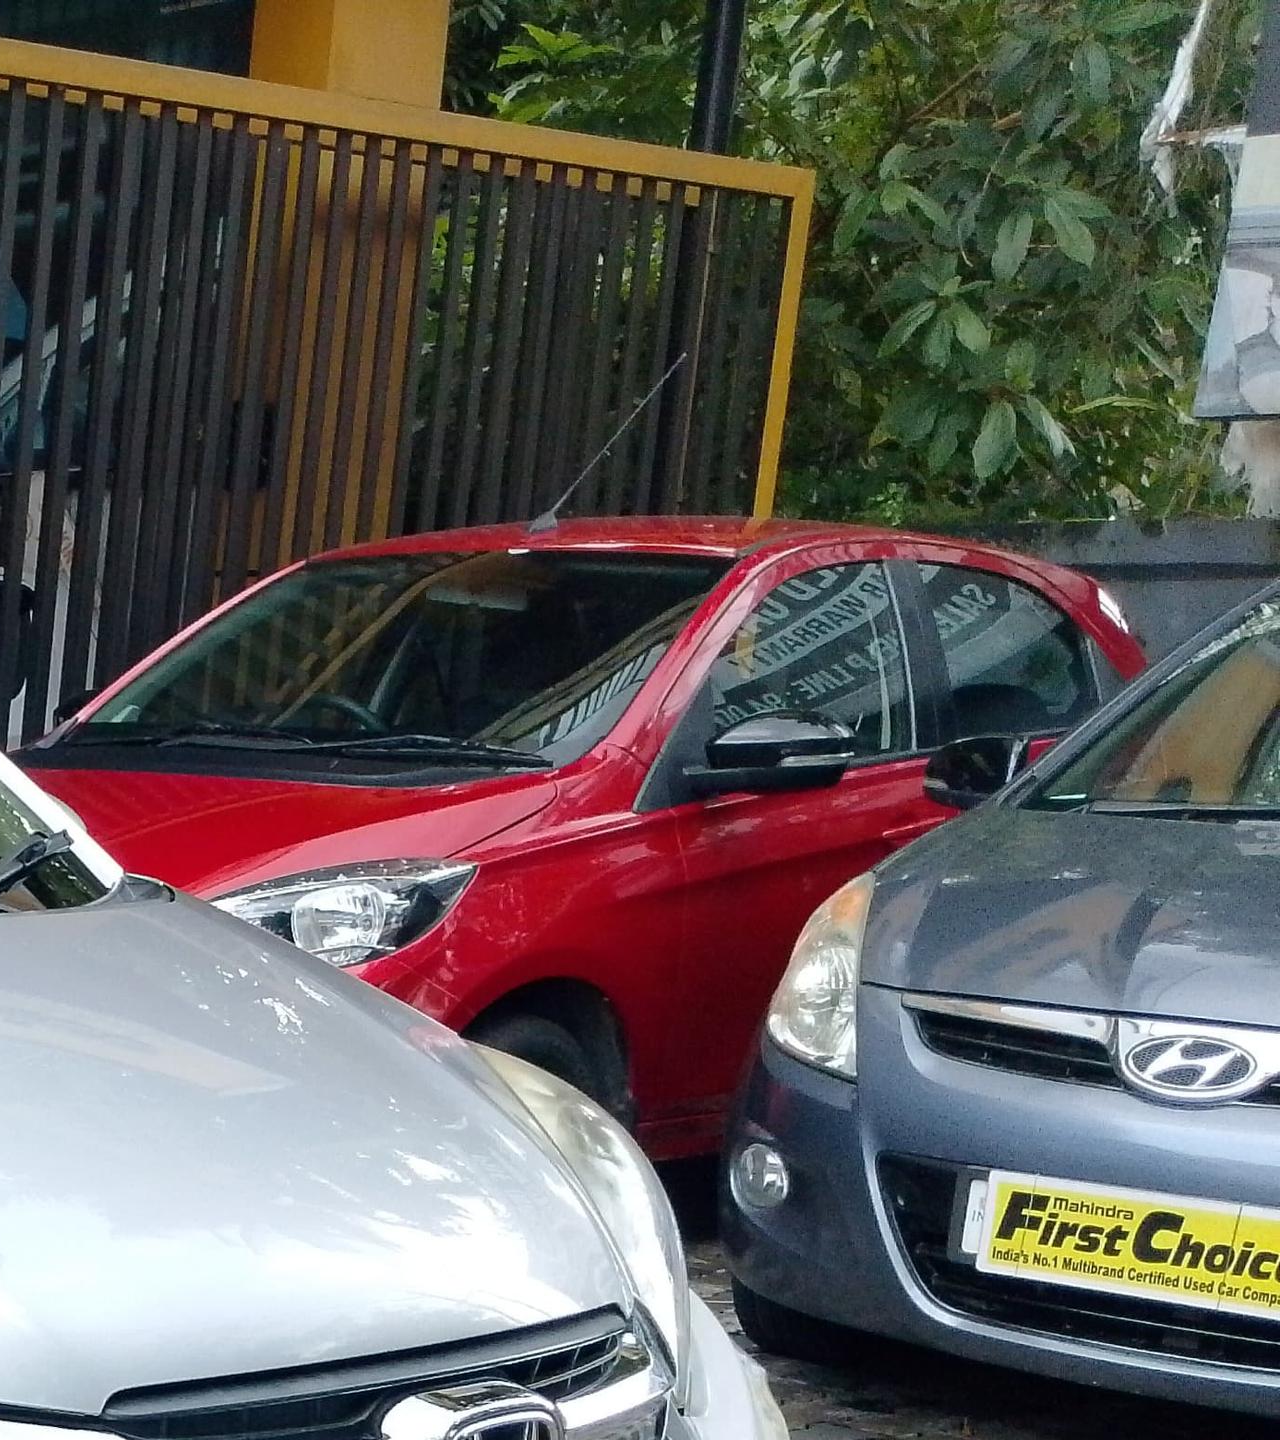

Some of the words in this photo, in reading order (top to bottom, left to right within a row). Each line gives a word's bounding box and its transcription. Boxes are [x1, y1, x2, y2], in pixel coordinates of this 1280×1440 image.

[1053, 1197, 1134, 1220] Mahindra
[995, 1191, 1129, 1256] First
[1133, 1211, 1280, 1286] Choic
[992, 1246, 1029, 1264] India's
[1062, 1257, 1124, 1279] Multibrand
[1128, 1268, 1180, 1287] Certified
[1184, 1276, 1214, 1293] Used
[1218, 1281, 1240, 1297] Car
